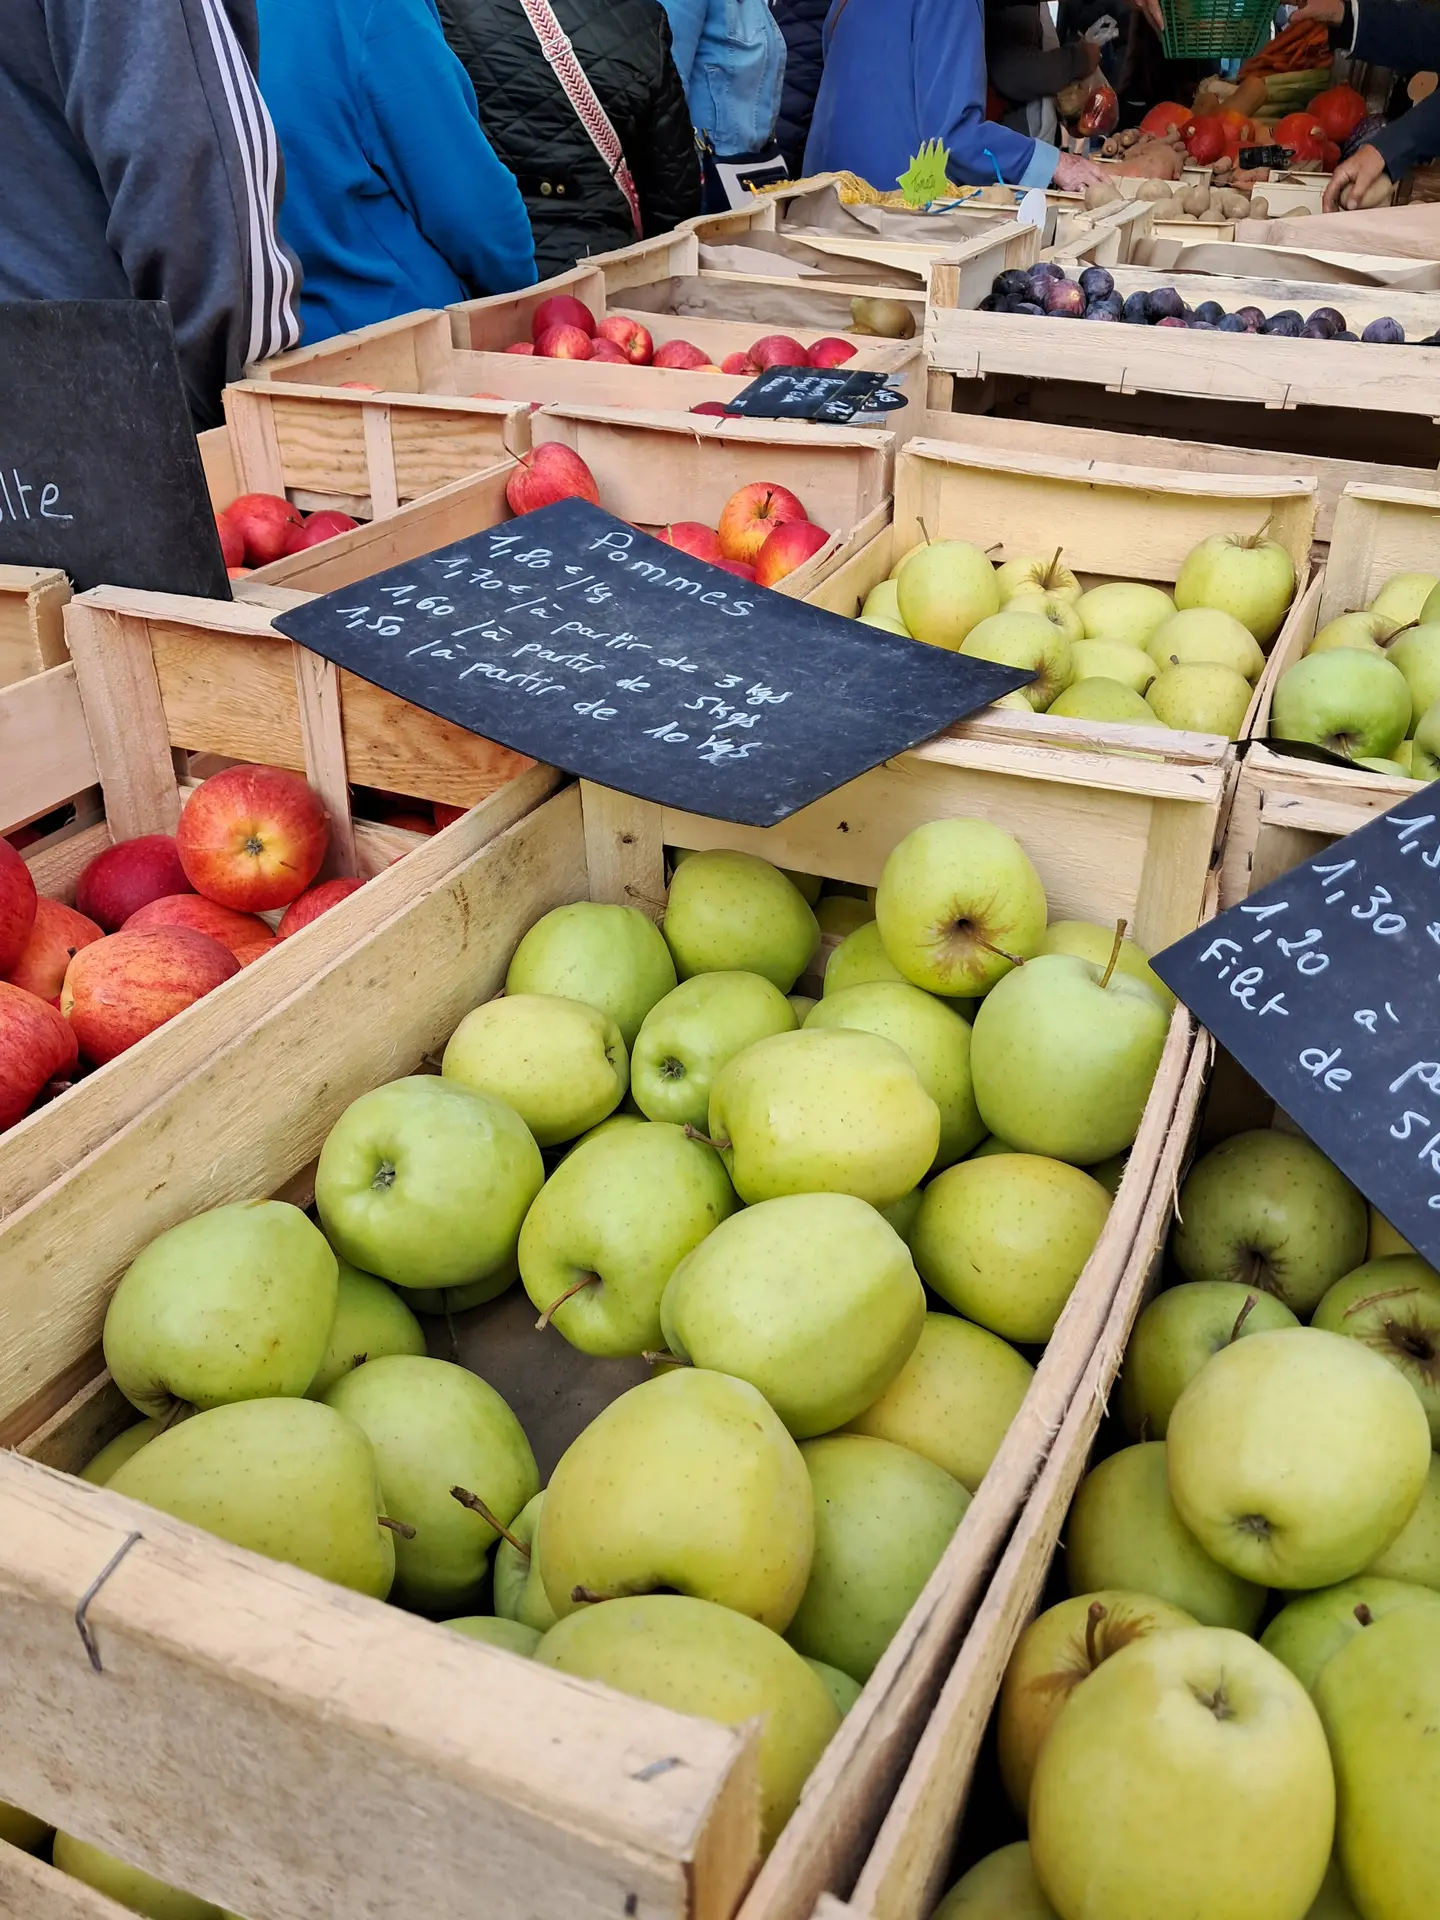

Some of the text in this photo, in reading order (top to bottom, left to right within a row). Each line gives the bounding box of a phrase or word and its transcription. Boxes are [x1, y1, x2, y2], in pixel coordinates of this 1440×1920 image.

[0, 468, 73, 521] lte
[490, 535, 553, 568] 1,80
[589, 532, 754, 616] Pommes
[336, 605, 405, 636] 1,50
[458, 661, 566, 696] partir
[573, 699, 618, 721] de
[380, 584, 455, 616] 1,60
[511, 642, 606, 675] partir
[615, 675, 651, 693] de
[549, 620, 653, 651] partir
[656, 656, 699, 673] de
[1312, 858, 1407, 935] 1,30
[1239, 900, 1331, 976] 1,20
[1353, 1002, 1399, 1034] à
[1199, 937, 1290, 1017] Filet
[1299, 1046, 1353, 1093] de
